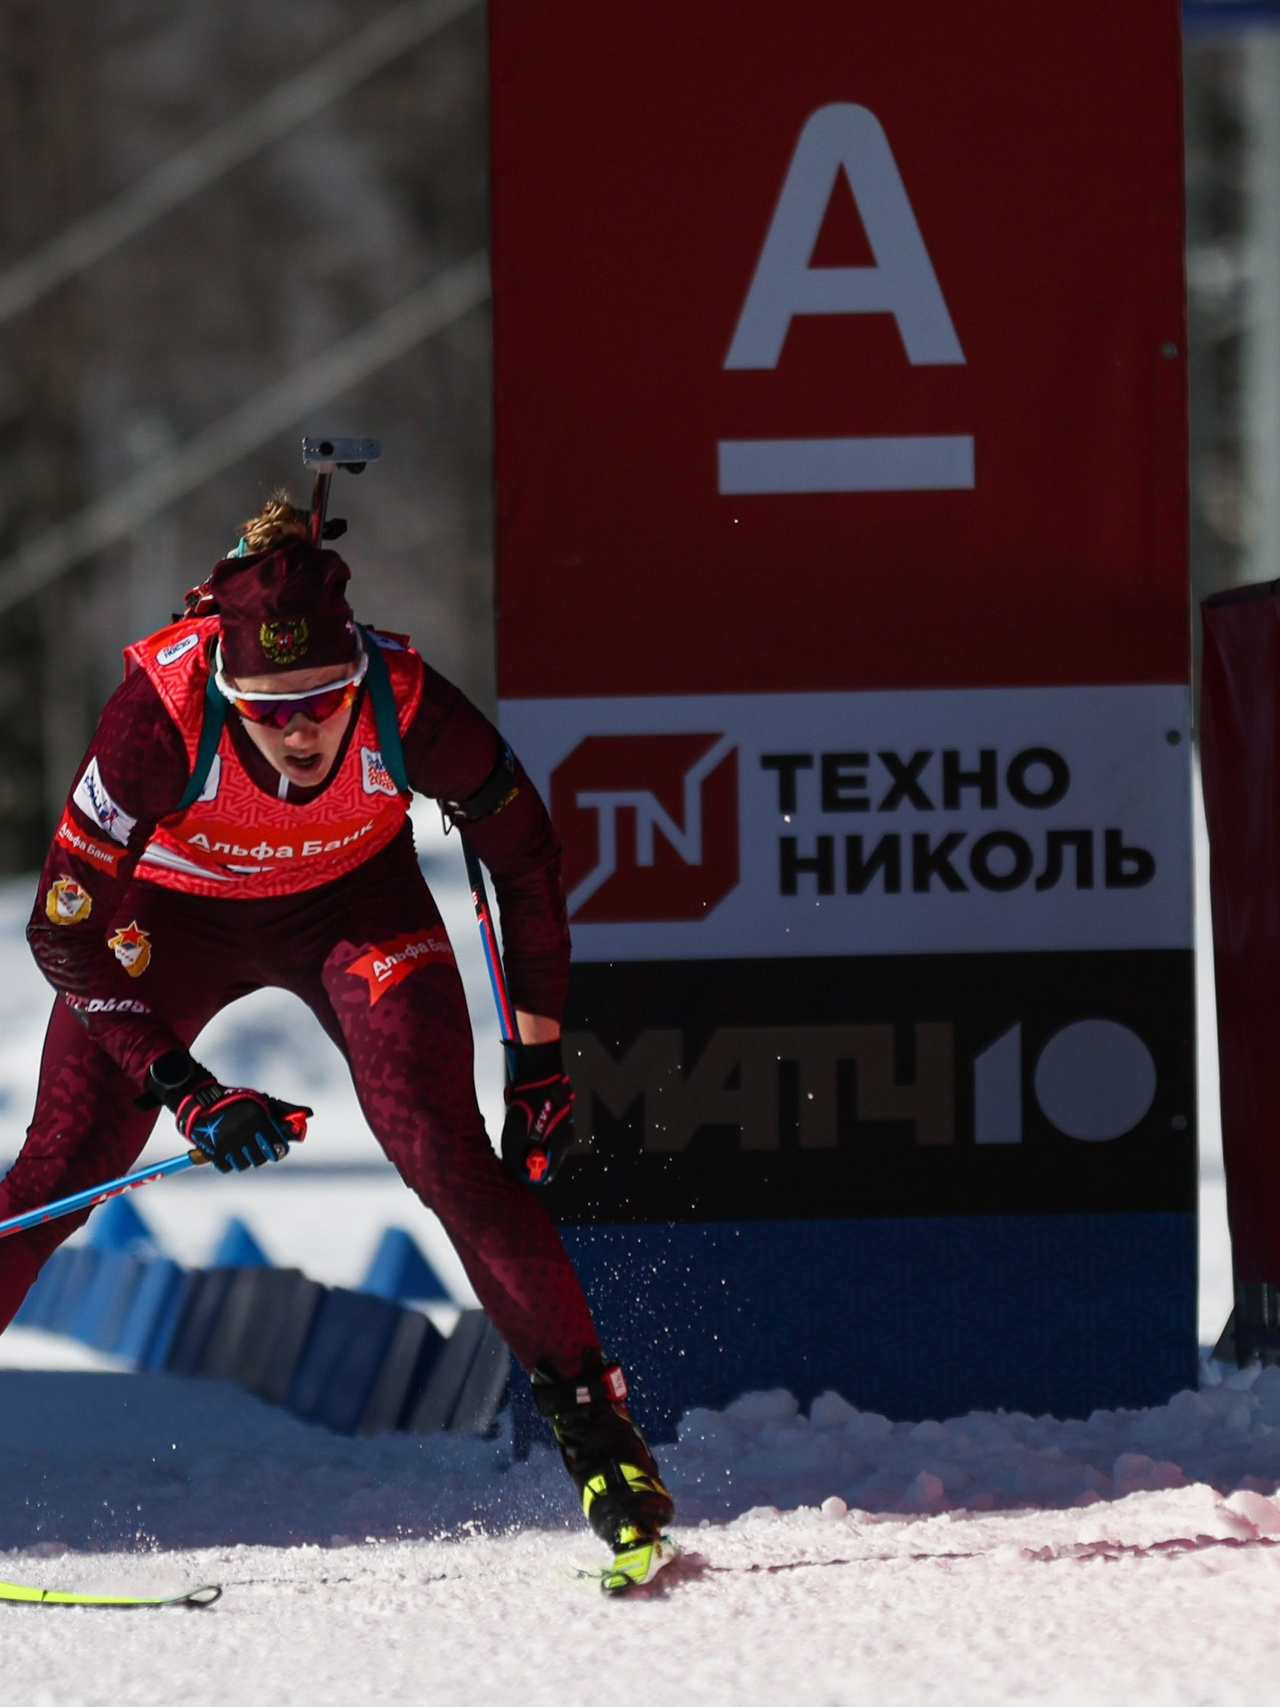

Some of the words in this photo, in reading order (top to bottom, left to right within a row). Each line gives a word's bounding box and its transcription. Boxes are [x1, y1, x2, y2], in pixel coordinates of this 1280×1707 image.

[760, 747, 1071, 816] ТЕХНО
[59, 822, 86, 851] Альфа
[87, 844, 114, 863] Банк
[187, 832, 294, 861] Альфа
[301, 819, 374, 857] Банк
[778, 829, 1156, 896] НИКОЛЬ
[373, 943, 428, 977] Альфа
[561, 1022, 955, 1154] МАТЧ
